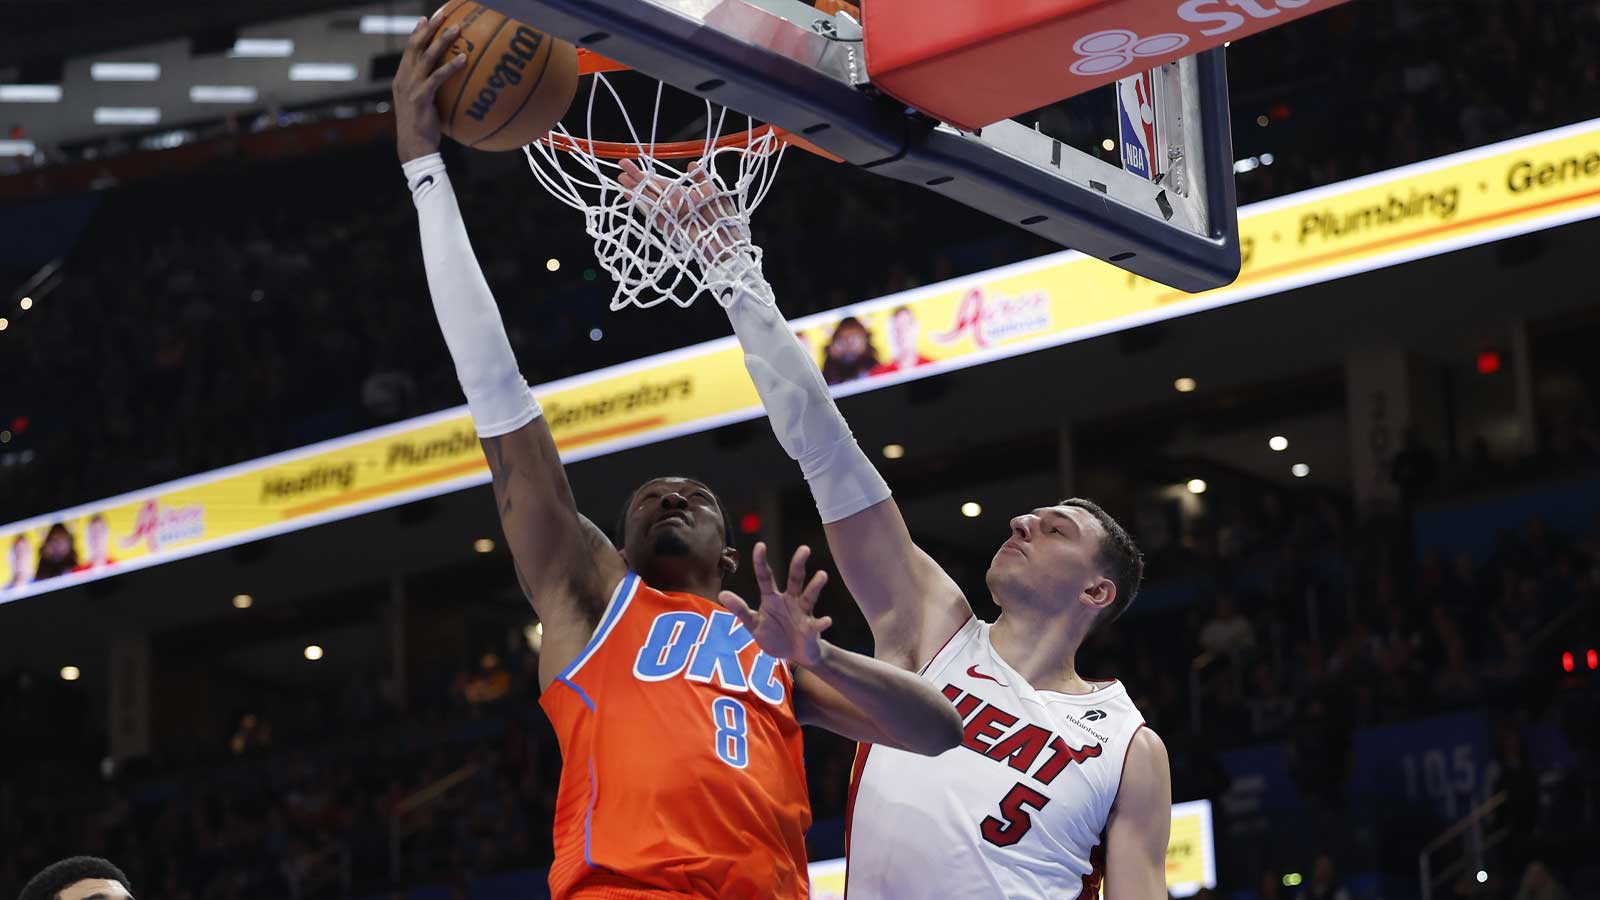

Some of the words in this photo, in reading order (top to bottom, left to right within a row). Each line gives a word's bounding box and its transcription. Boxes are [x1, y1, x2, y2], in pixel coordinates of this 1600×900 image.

[1177, 0, 1312, 37] St
[463, 25, 543, 121] Wilson
[1125, 142, 1145, 171] NBA
[1298, 184, 1458, 246] Plumbing
[260, 461, 356, 504] Heating
[384, 424, 478, 474] Plumbi
[633, 610, 784, 705] OKC
[712, 696, 748, 769] 8
[1066, 714, 1109, 744] Robinhood
[980, 782, 1050, 847] 5
